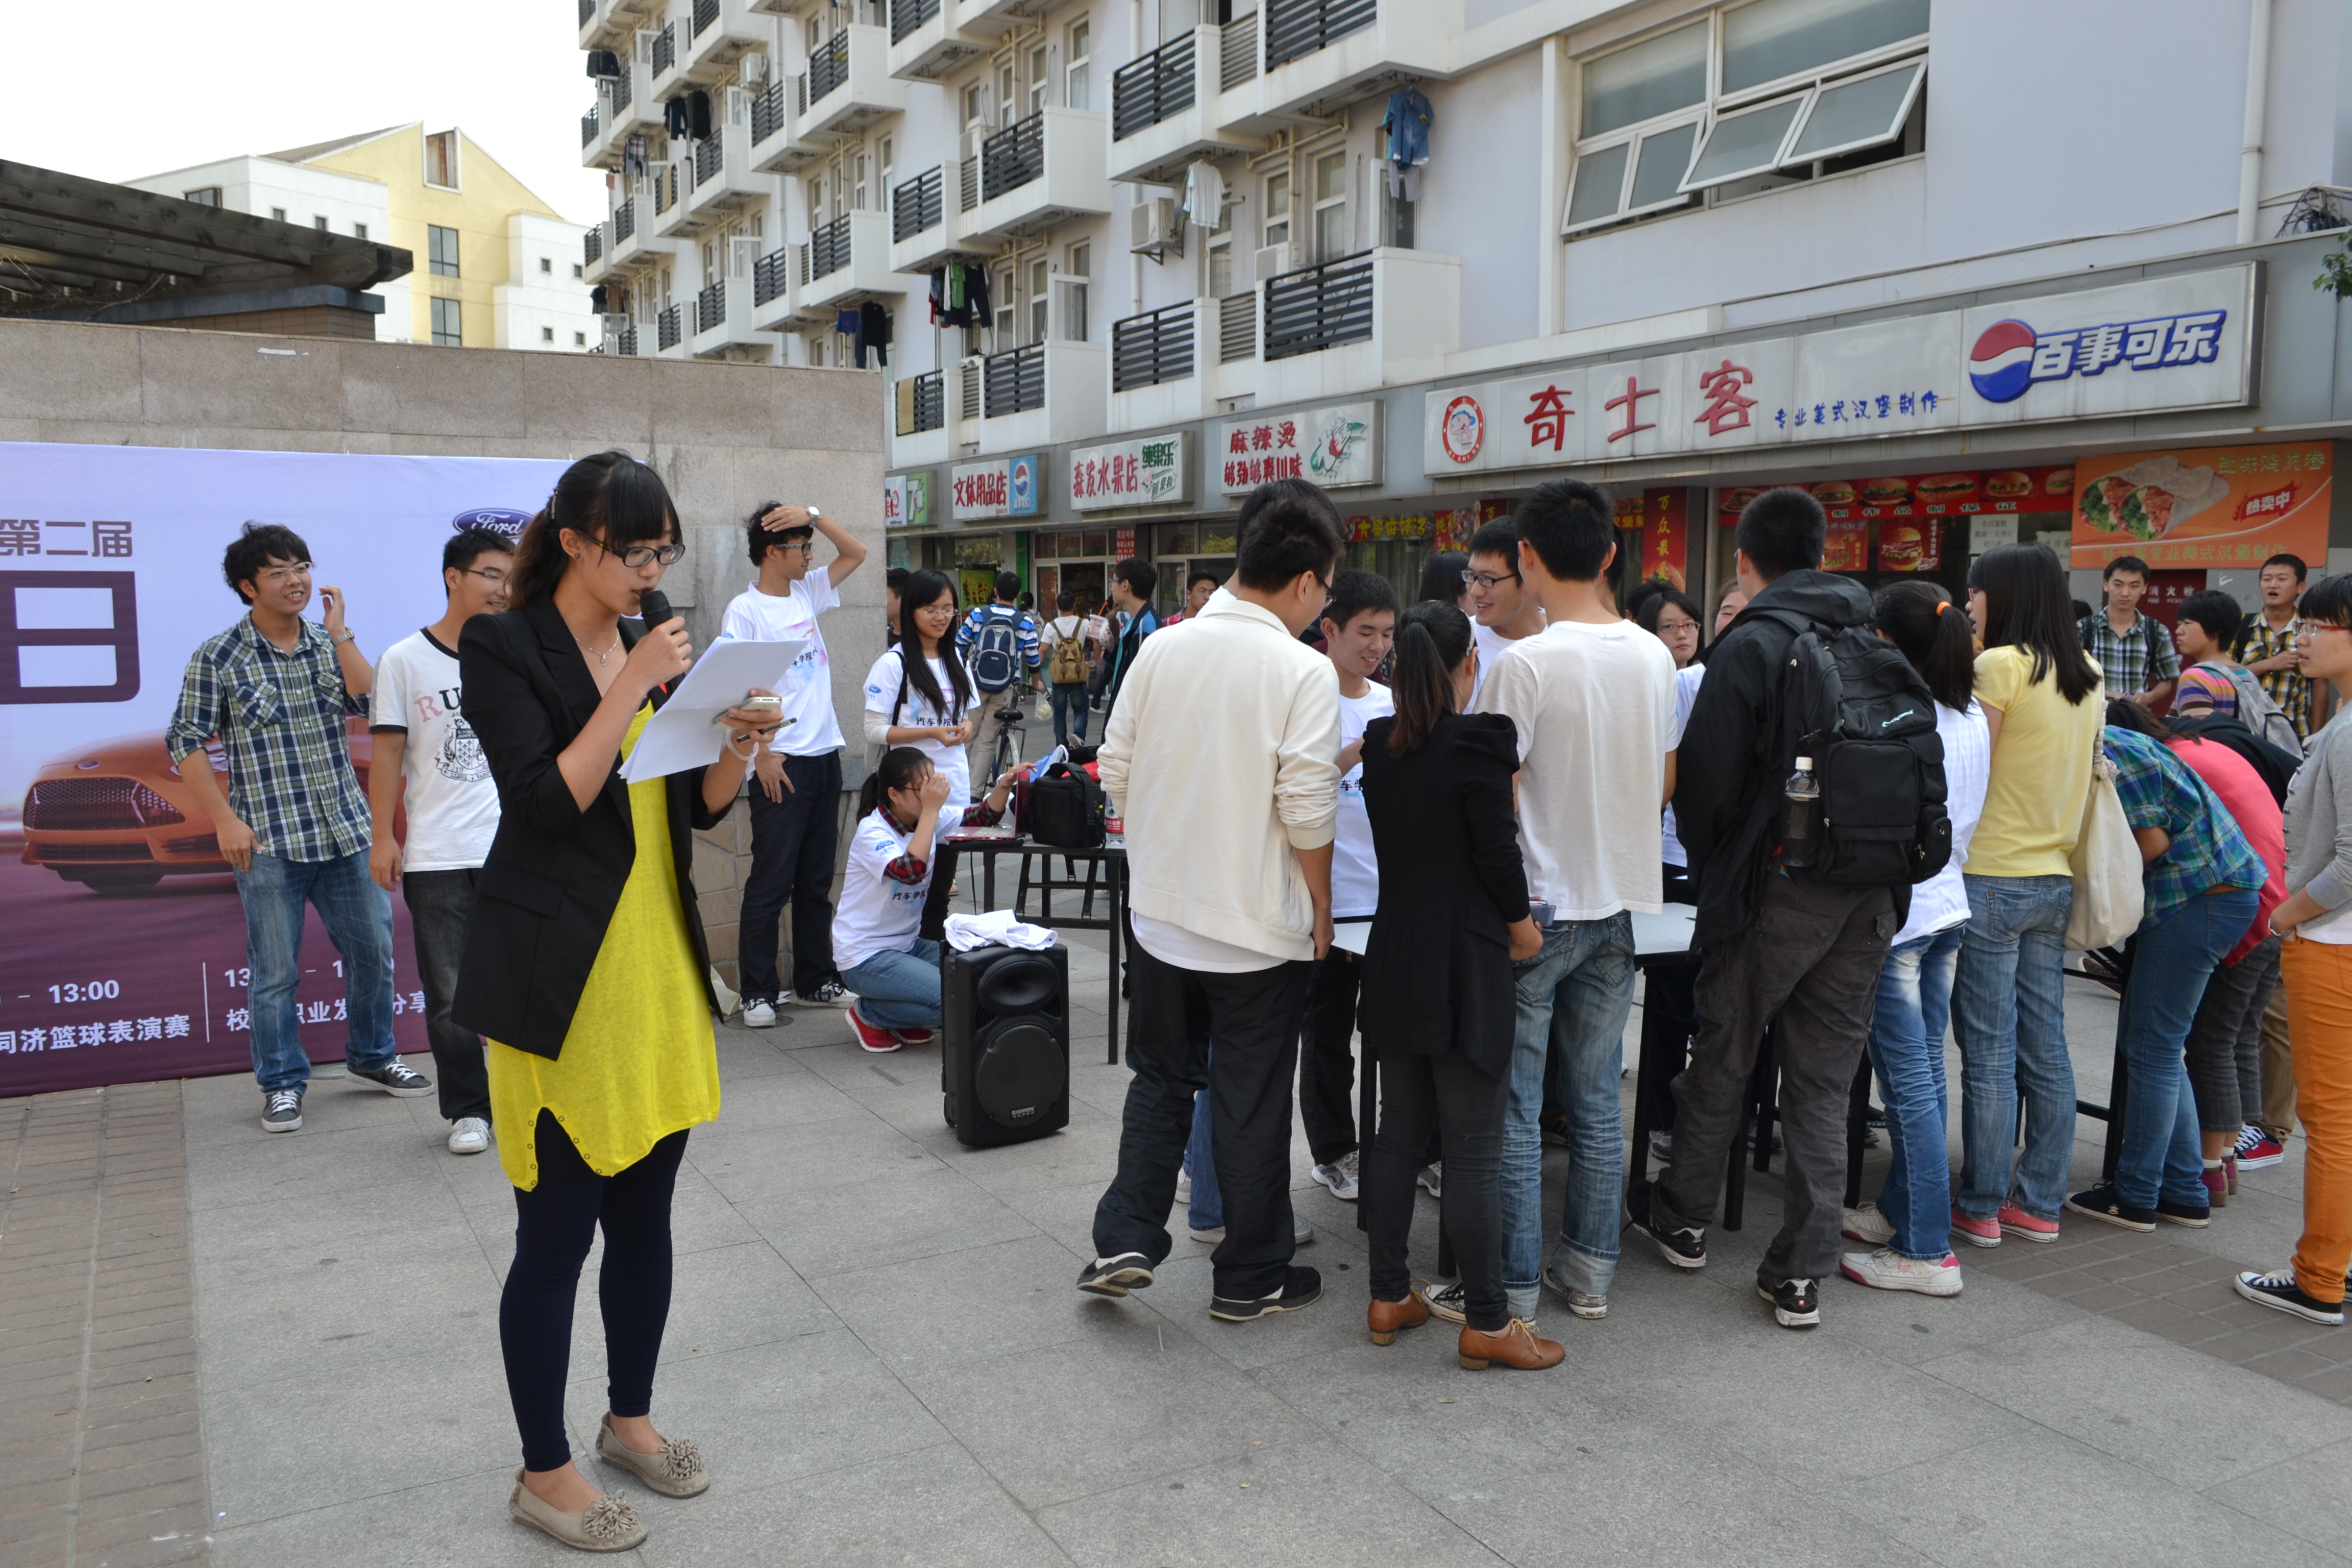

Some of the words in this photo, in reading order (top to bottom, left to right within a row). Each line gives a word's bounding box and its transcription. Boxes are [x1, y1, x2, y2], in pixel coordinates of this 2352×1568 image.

[2029, 309, 2226, 380] 百事可乐
[1524, 359, 1758, 451] 奇士客
[1775, 390, 1939, 428] 专业美式汉堡制作
[1142, 440, 1176, 469] 纯果乐
[1230, 421, 1296, 454] 麻辣烫
[1224, 452, 1303, 487] 够劲够爽川味
[953, 470, 1008, 507] 文体用品店
[2246, 491, 2291, 516] 热卖中
[0, 519, 133, 557] 第二届
[2149, 585, 2194, 596] 消火栓
[48, 980, 120, 1003] 13:00
